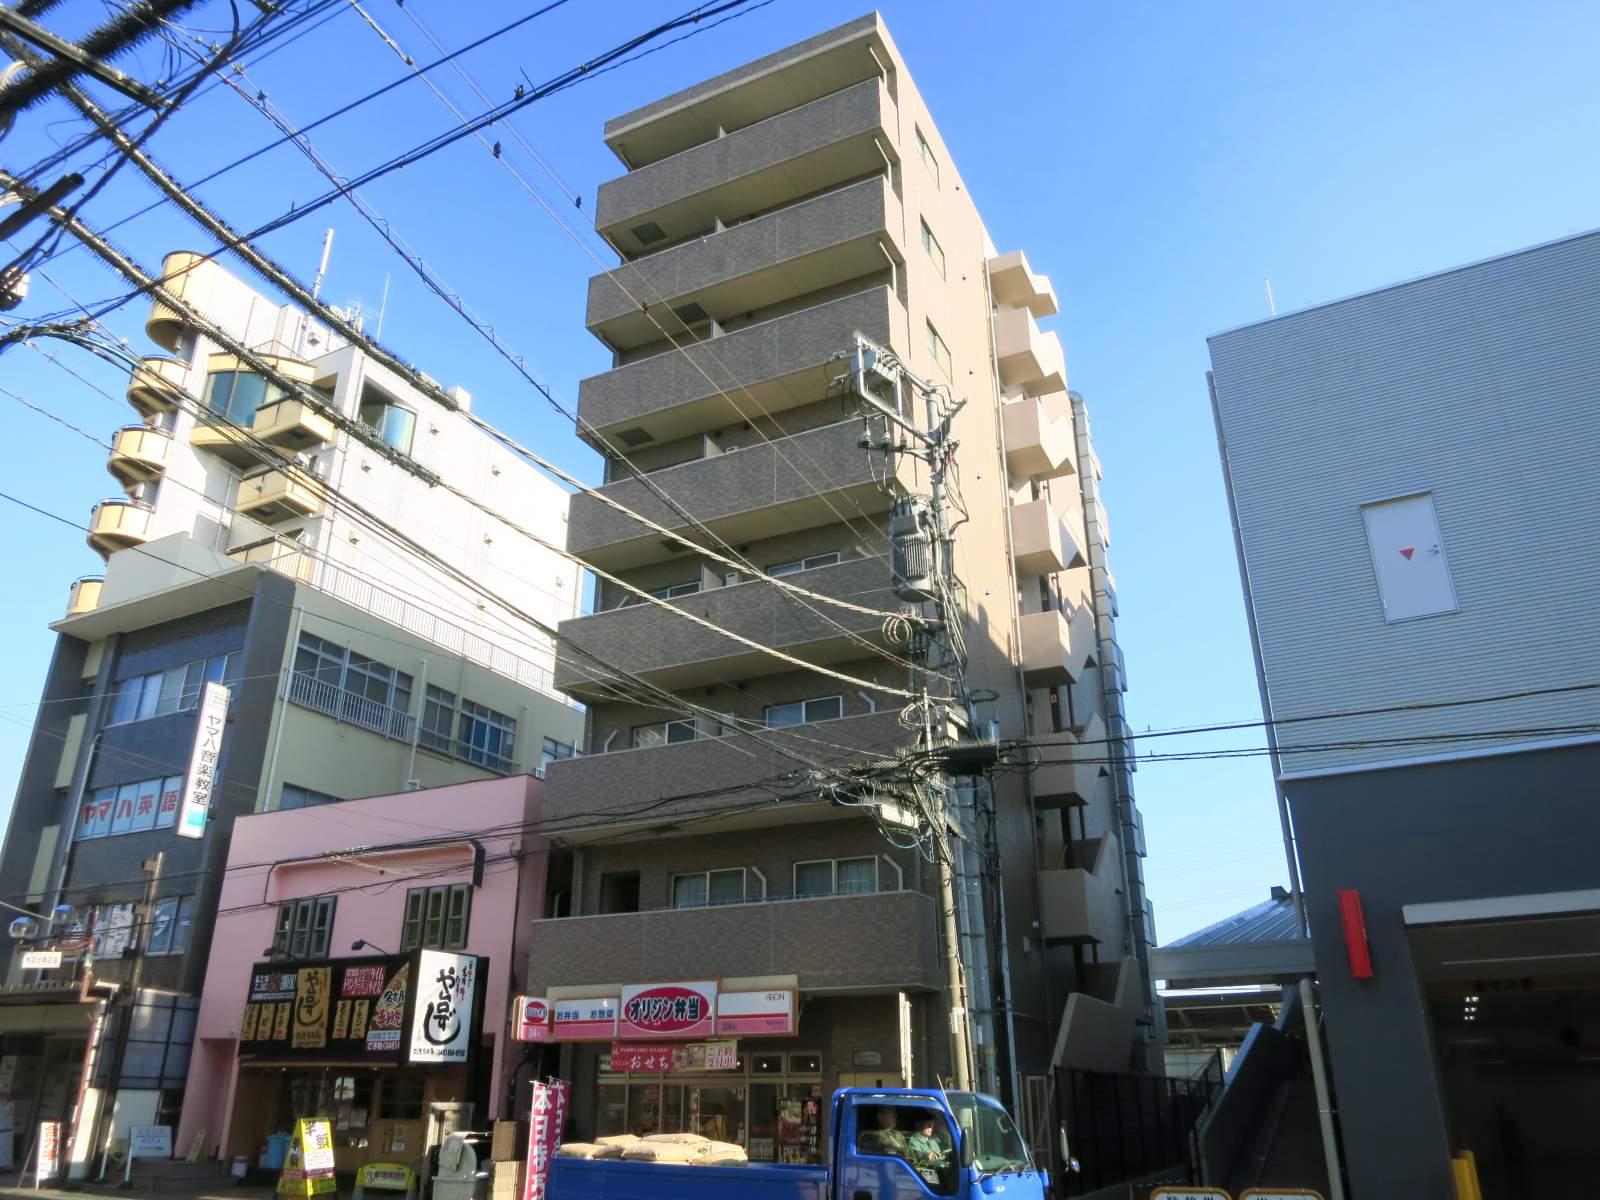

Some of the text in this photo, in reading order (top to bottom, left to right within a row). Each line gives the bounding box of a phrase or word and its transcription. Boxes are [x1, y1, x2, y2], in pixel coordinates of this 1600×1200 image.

[192, 714, 222, 806] ヤマハ音楽教室
[82, 790, 180, 825] ヤマハ英語
[556, 1011, 580, 1020] お弁当
[629, 995, 700, 1022] オリジン弁当
[630, 1055, 669, 1069] おせち
